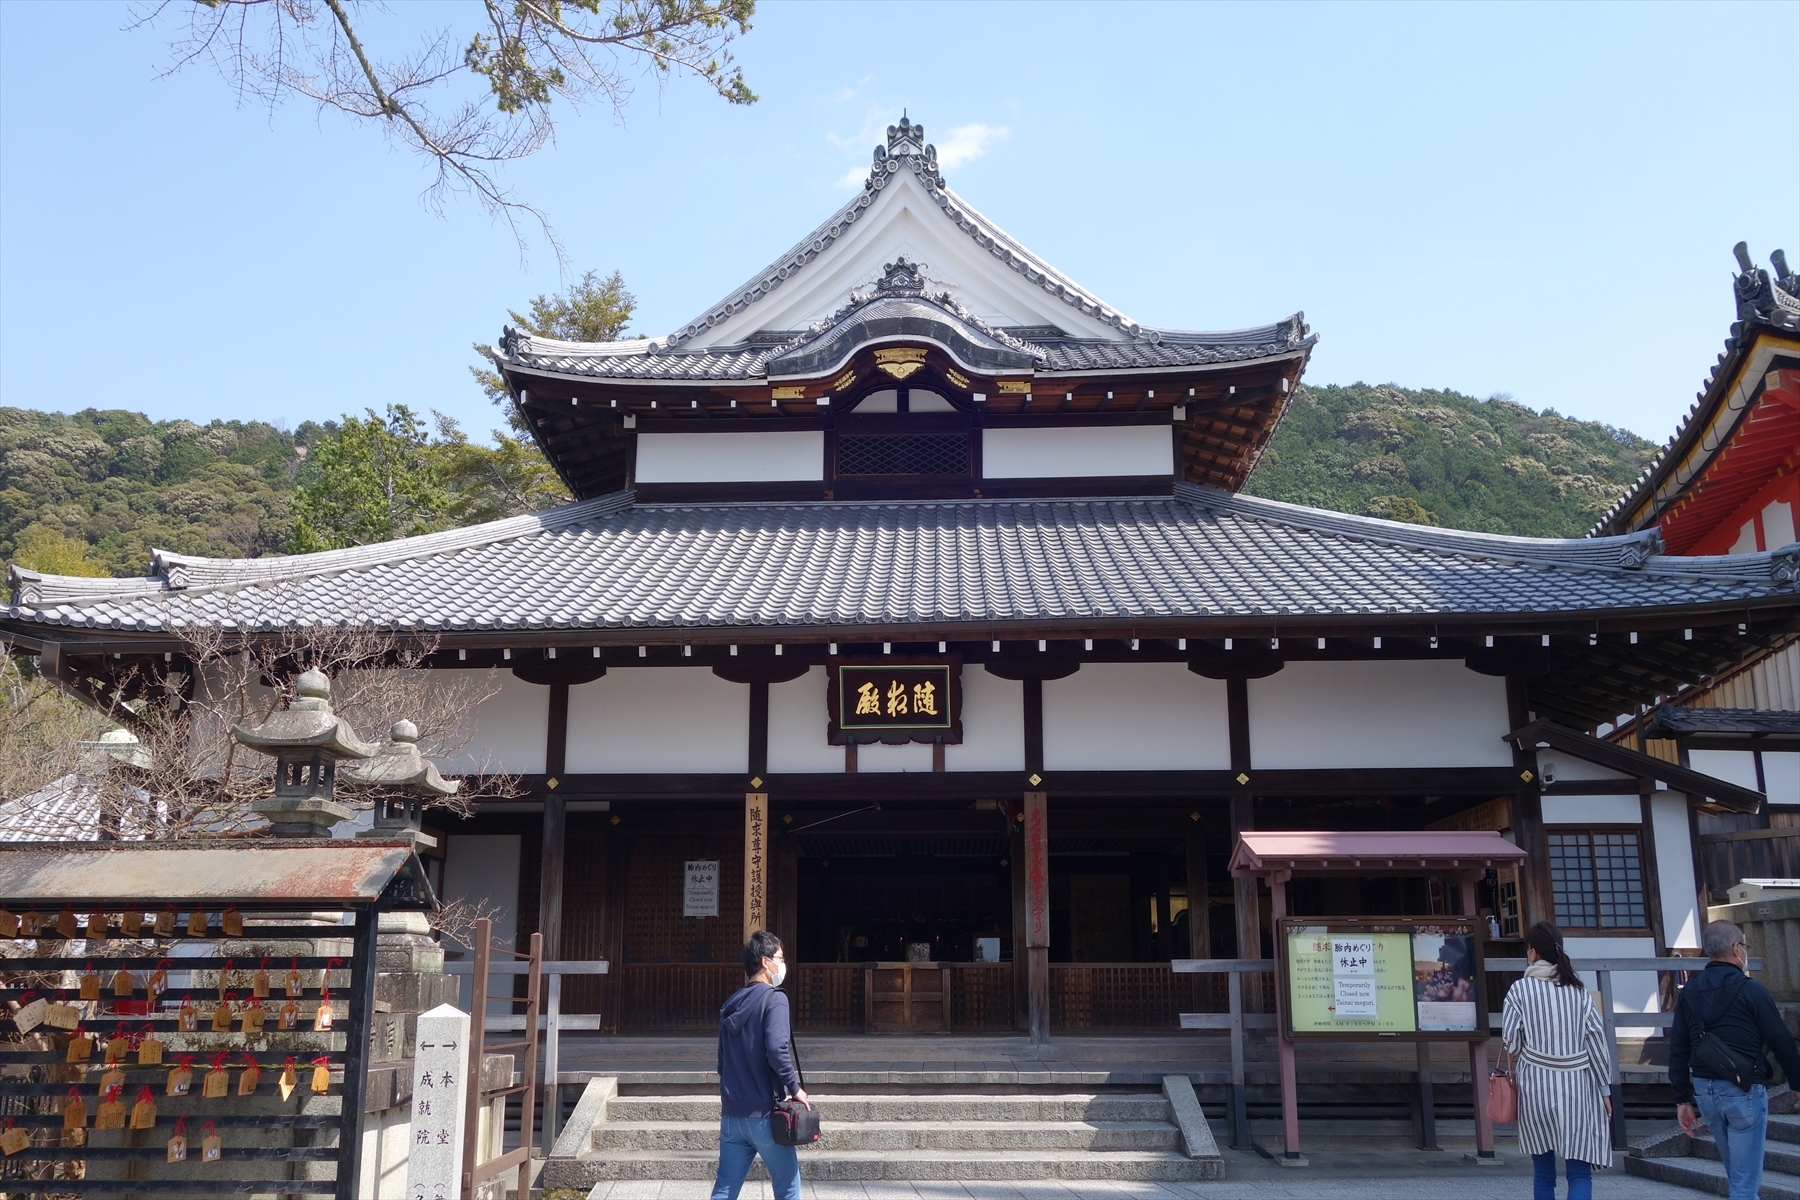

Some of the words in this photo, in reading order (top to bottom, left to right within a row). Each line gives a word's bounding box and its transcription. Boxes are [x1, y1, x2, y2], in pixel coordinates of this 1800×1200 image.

[691, 874, 713, 883] 休止中
[1334, 943, 1371, 952] 胎内めぐり
[1339, 957, 1367, 967] 休止中
[416, 1070, 434, 1145] 成就院
[436, 1070, 454, 1145] 本堂
